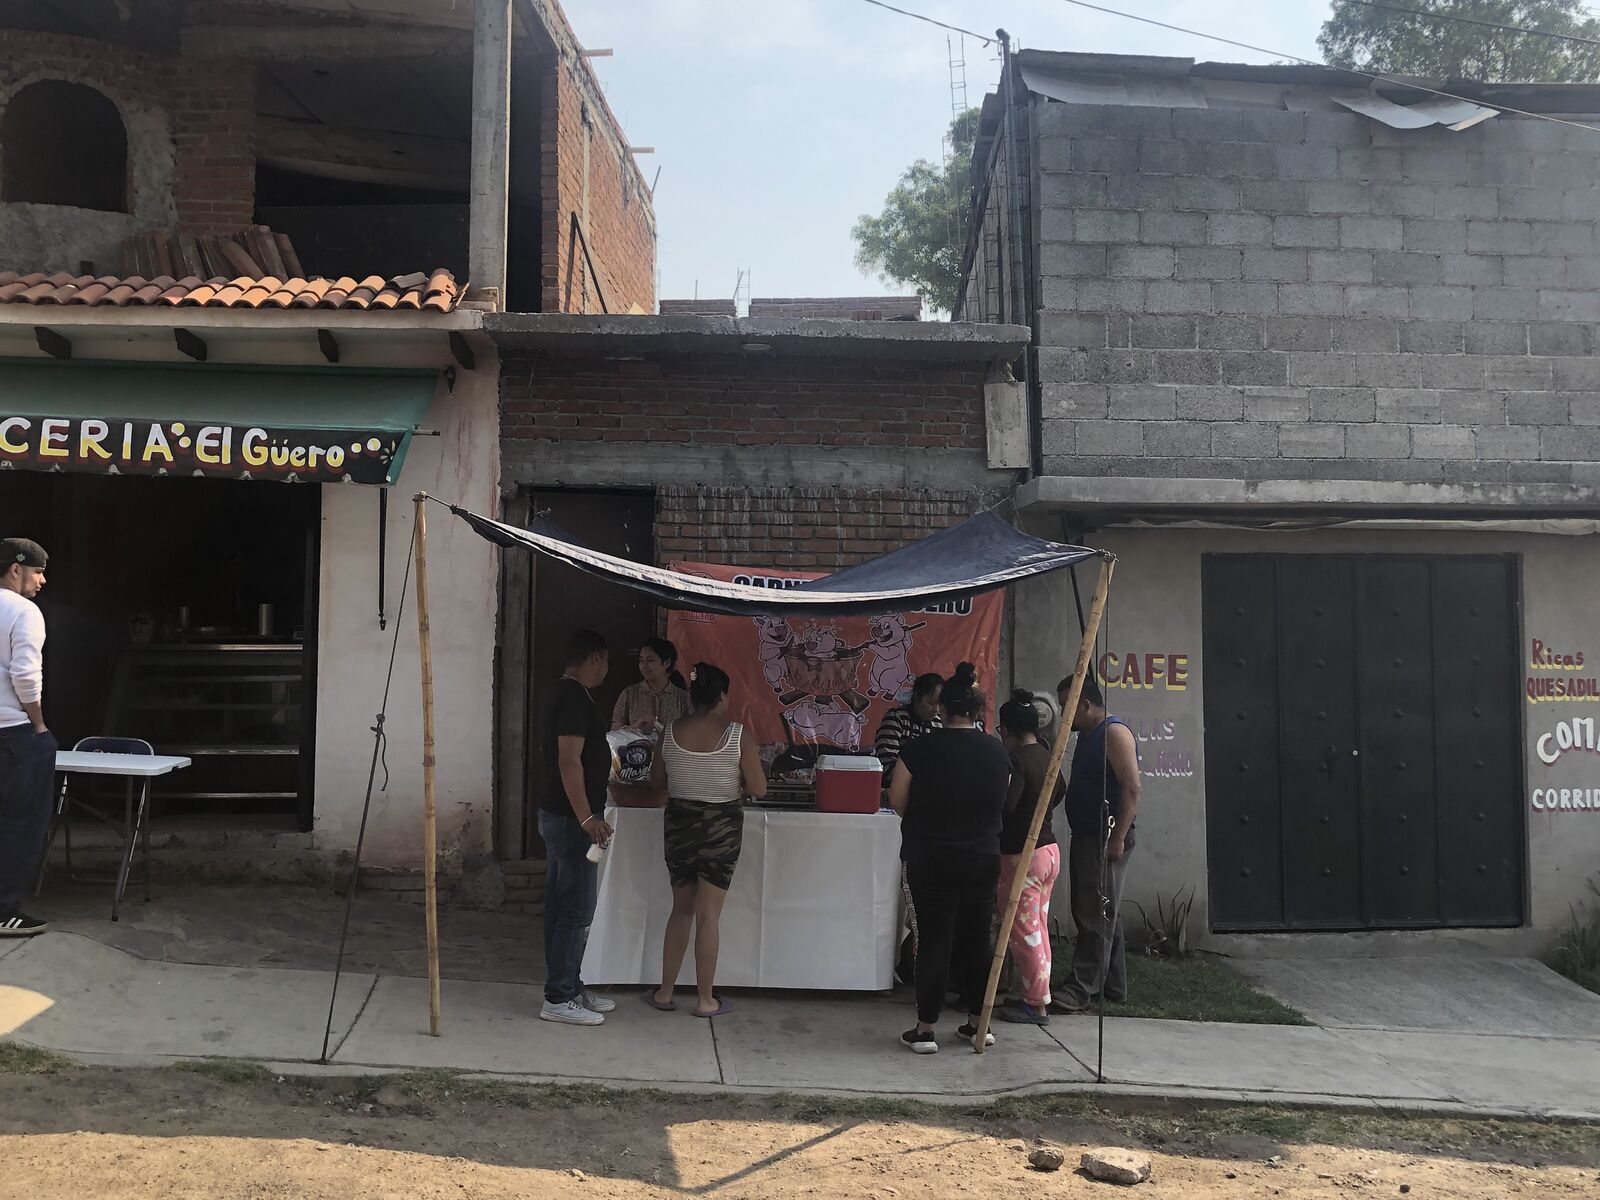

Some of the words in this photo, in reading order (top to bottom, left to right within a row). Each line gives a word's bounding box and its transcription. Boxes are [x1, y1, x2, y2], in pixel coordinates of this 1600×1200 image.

[0, 417, 173, 462] CERIA
[196, 426, 232, 464] El
[242, 428, 345, 467] Güero
[1099, 652, 1188, 689] CAFE
[1531, 638, 1584, 669] Ricas
[1537, 717, 1600, 763] COM
